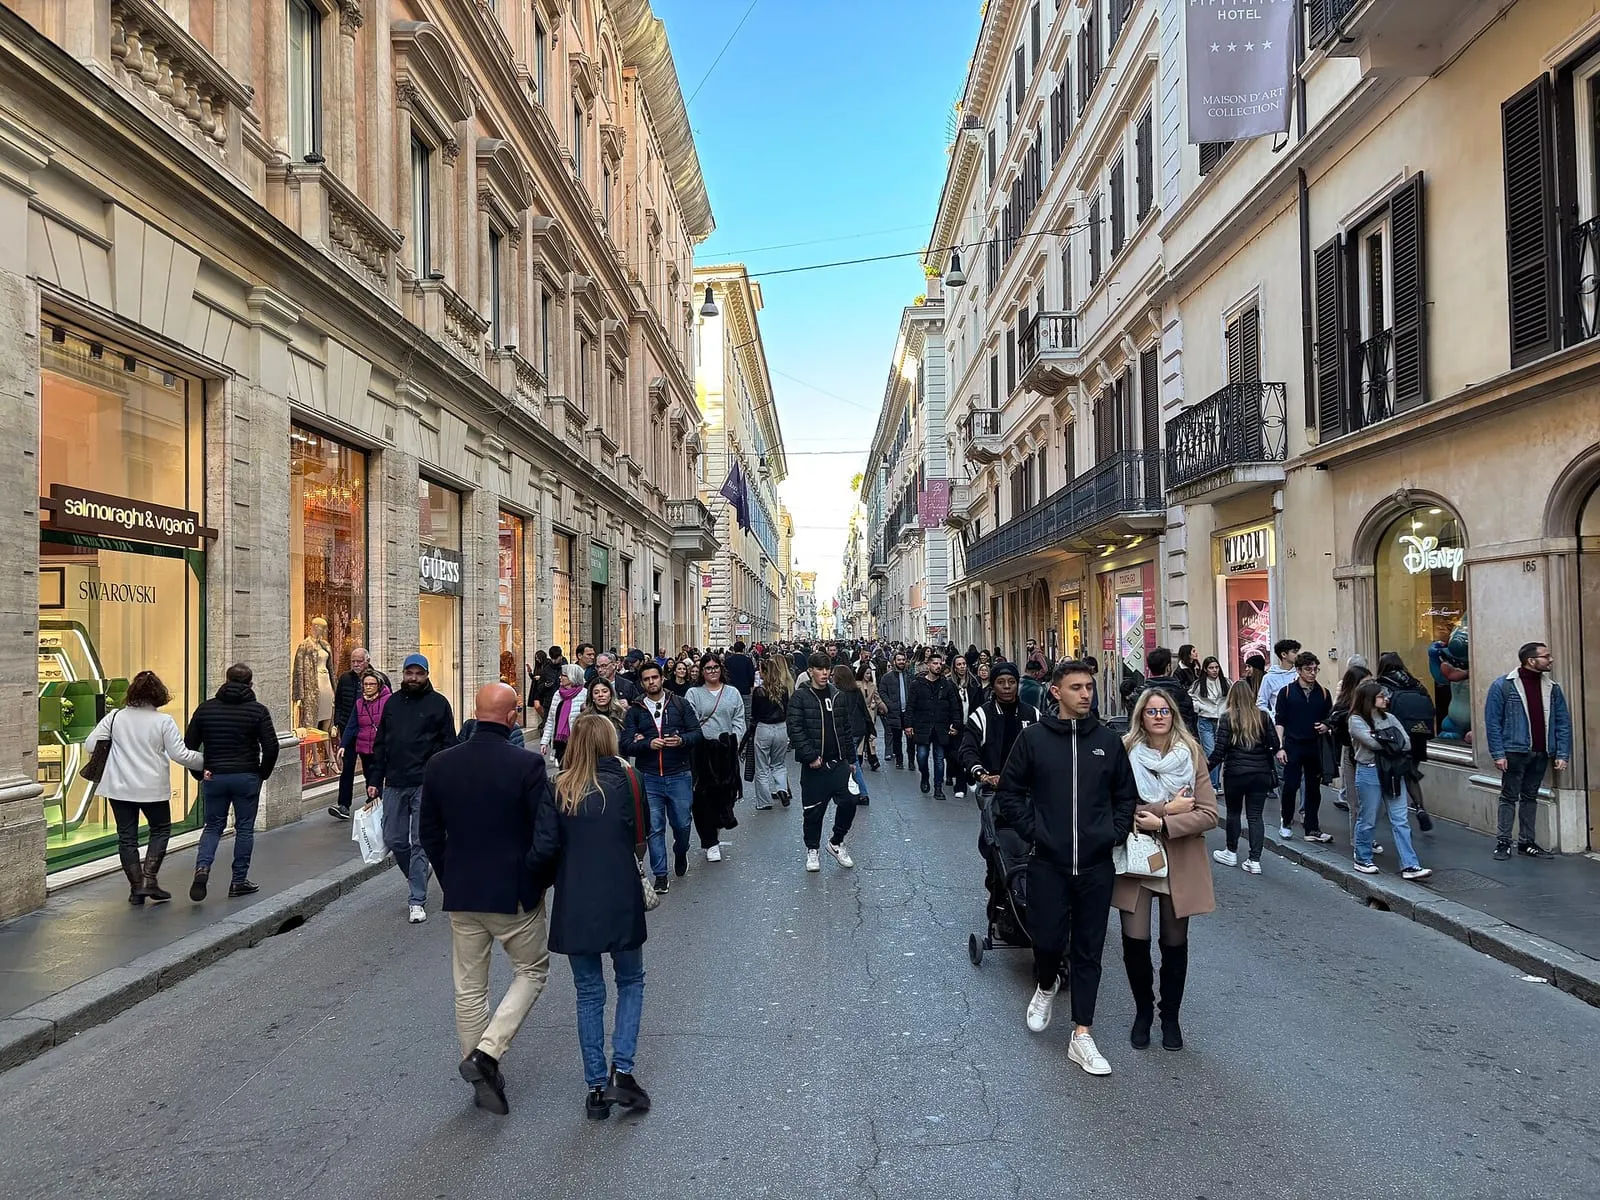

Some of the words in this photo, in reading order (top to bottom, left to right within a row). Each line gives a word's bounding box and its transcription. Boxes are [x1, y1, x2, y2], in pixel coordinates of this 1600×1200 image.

[1217, 9, 1262, 20] HOTEL
[1203, 95, 1247, 105] MAISON
[1249, 87, 1285, 103] D'ART
[1207, 100, 1279, 118] COLLECTION
[64, 497, 144, 530] salmoiraghi
[1223, 530, 1264, 564] WYCON
[421, 555, 460, 583] GUESS
[1522, 560, 1537, 573] 165
[79, 580, 156, 604] SWAROVSKI
